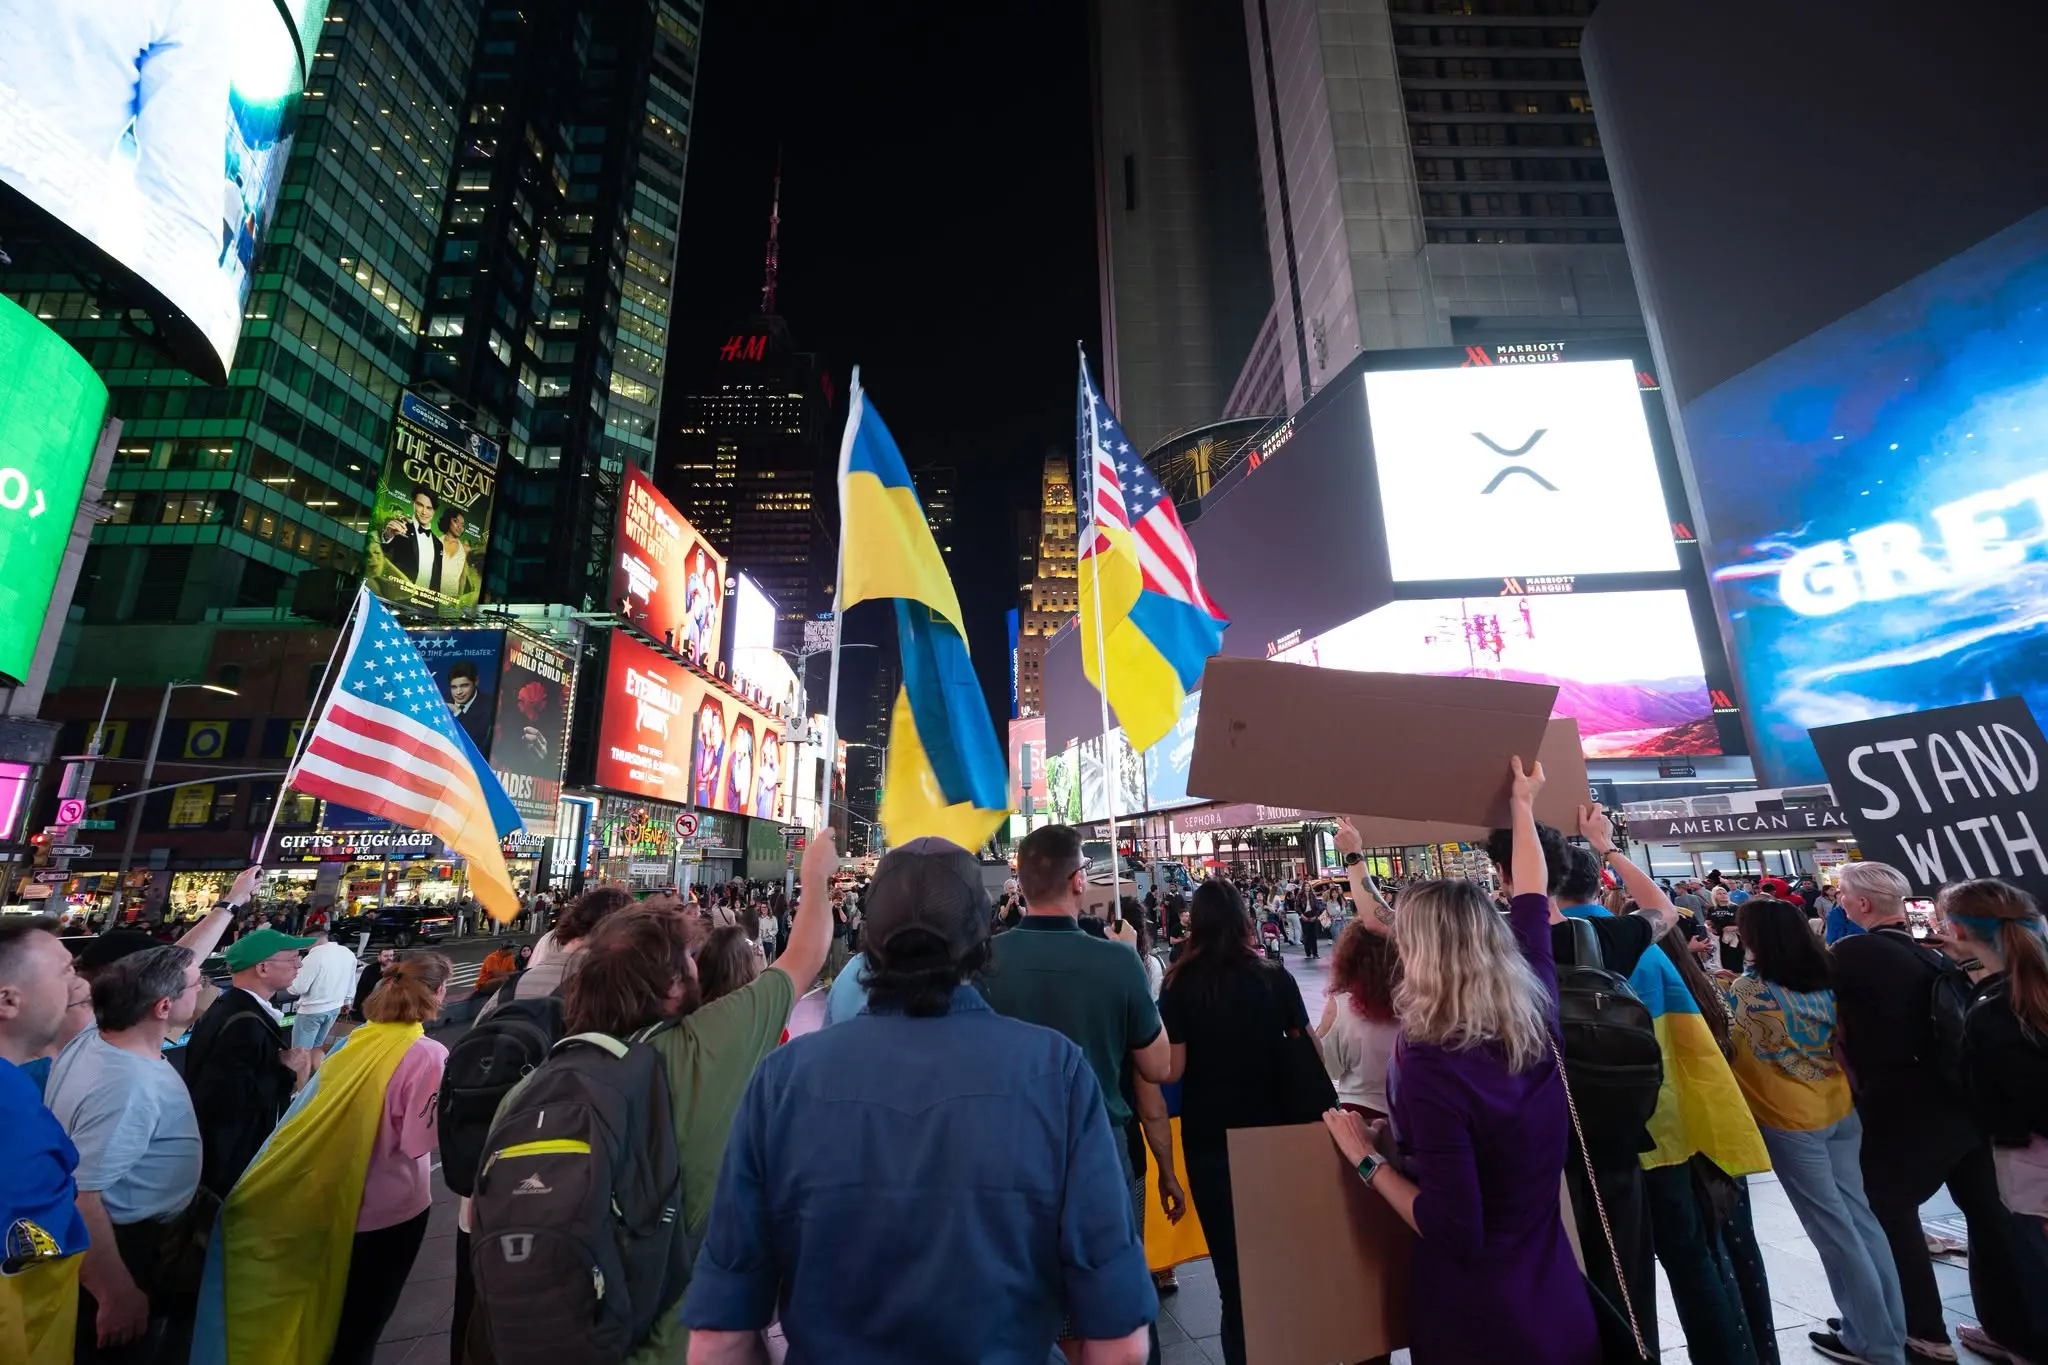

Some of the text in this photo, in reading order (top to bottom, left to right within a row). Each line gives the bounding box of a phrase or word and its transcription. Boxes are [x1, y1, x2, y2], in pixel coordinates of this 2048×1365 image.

[720, 336, 767, 360] H&M
[1497, 343, 1565, 354] MARRIOTT
[1499, 353, 1560, 364] MARQUIS
[397, 417, 496, 475] THE PARTY'S ROARING ON BROADWAY
[1262, 416, 1296, 450] MARRIOTT
[1263, 429, 1293, 460] MARQUIS
[395, 426, 495, 497] THE GREAT
[403, 458, 481, 508] GATSBY
[636, 486, 656, 517] NEW
[627, 497, 656, 536] FAMILY
[625, 515, 647, 550] WITH
[1526, 576, 1575, 585] MARRIOTT
[1527, 584, 1572, 593] MARQUIS
[510, 648, 572, 686] WORLD COULD BE
[521, 641, 534, 654] COME
[535, 645, 545, 659] SEE
[555, 653, 564, 669] THE
[1848, 722, 2039, 821] STAND
[1185, 813, 1222, 828] SEPHORA
[1669, 814, 1788, 835] AMERICAN
[280, 836, 333, 848] GIFTS
[353, 847, 370, 855] NY
[508, 832, 546, 848] LUGGAGE
[1897, 811, 2048, 886] WITH
